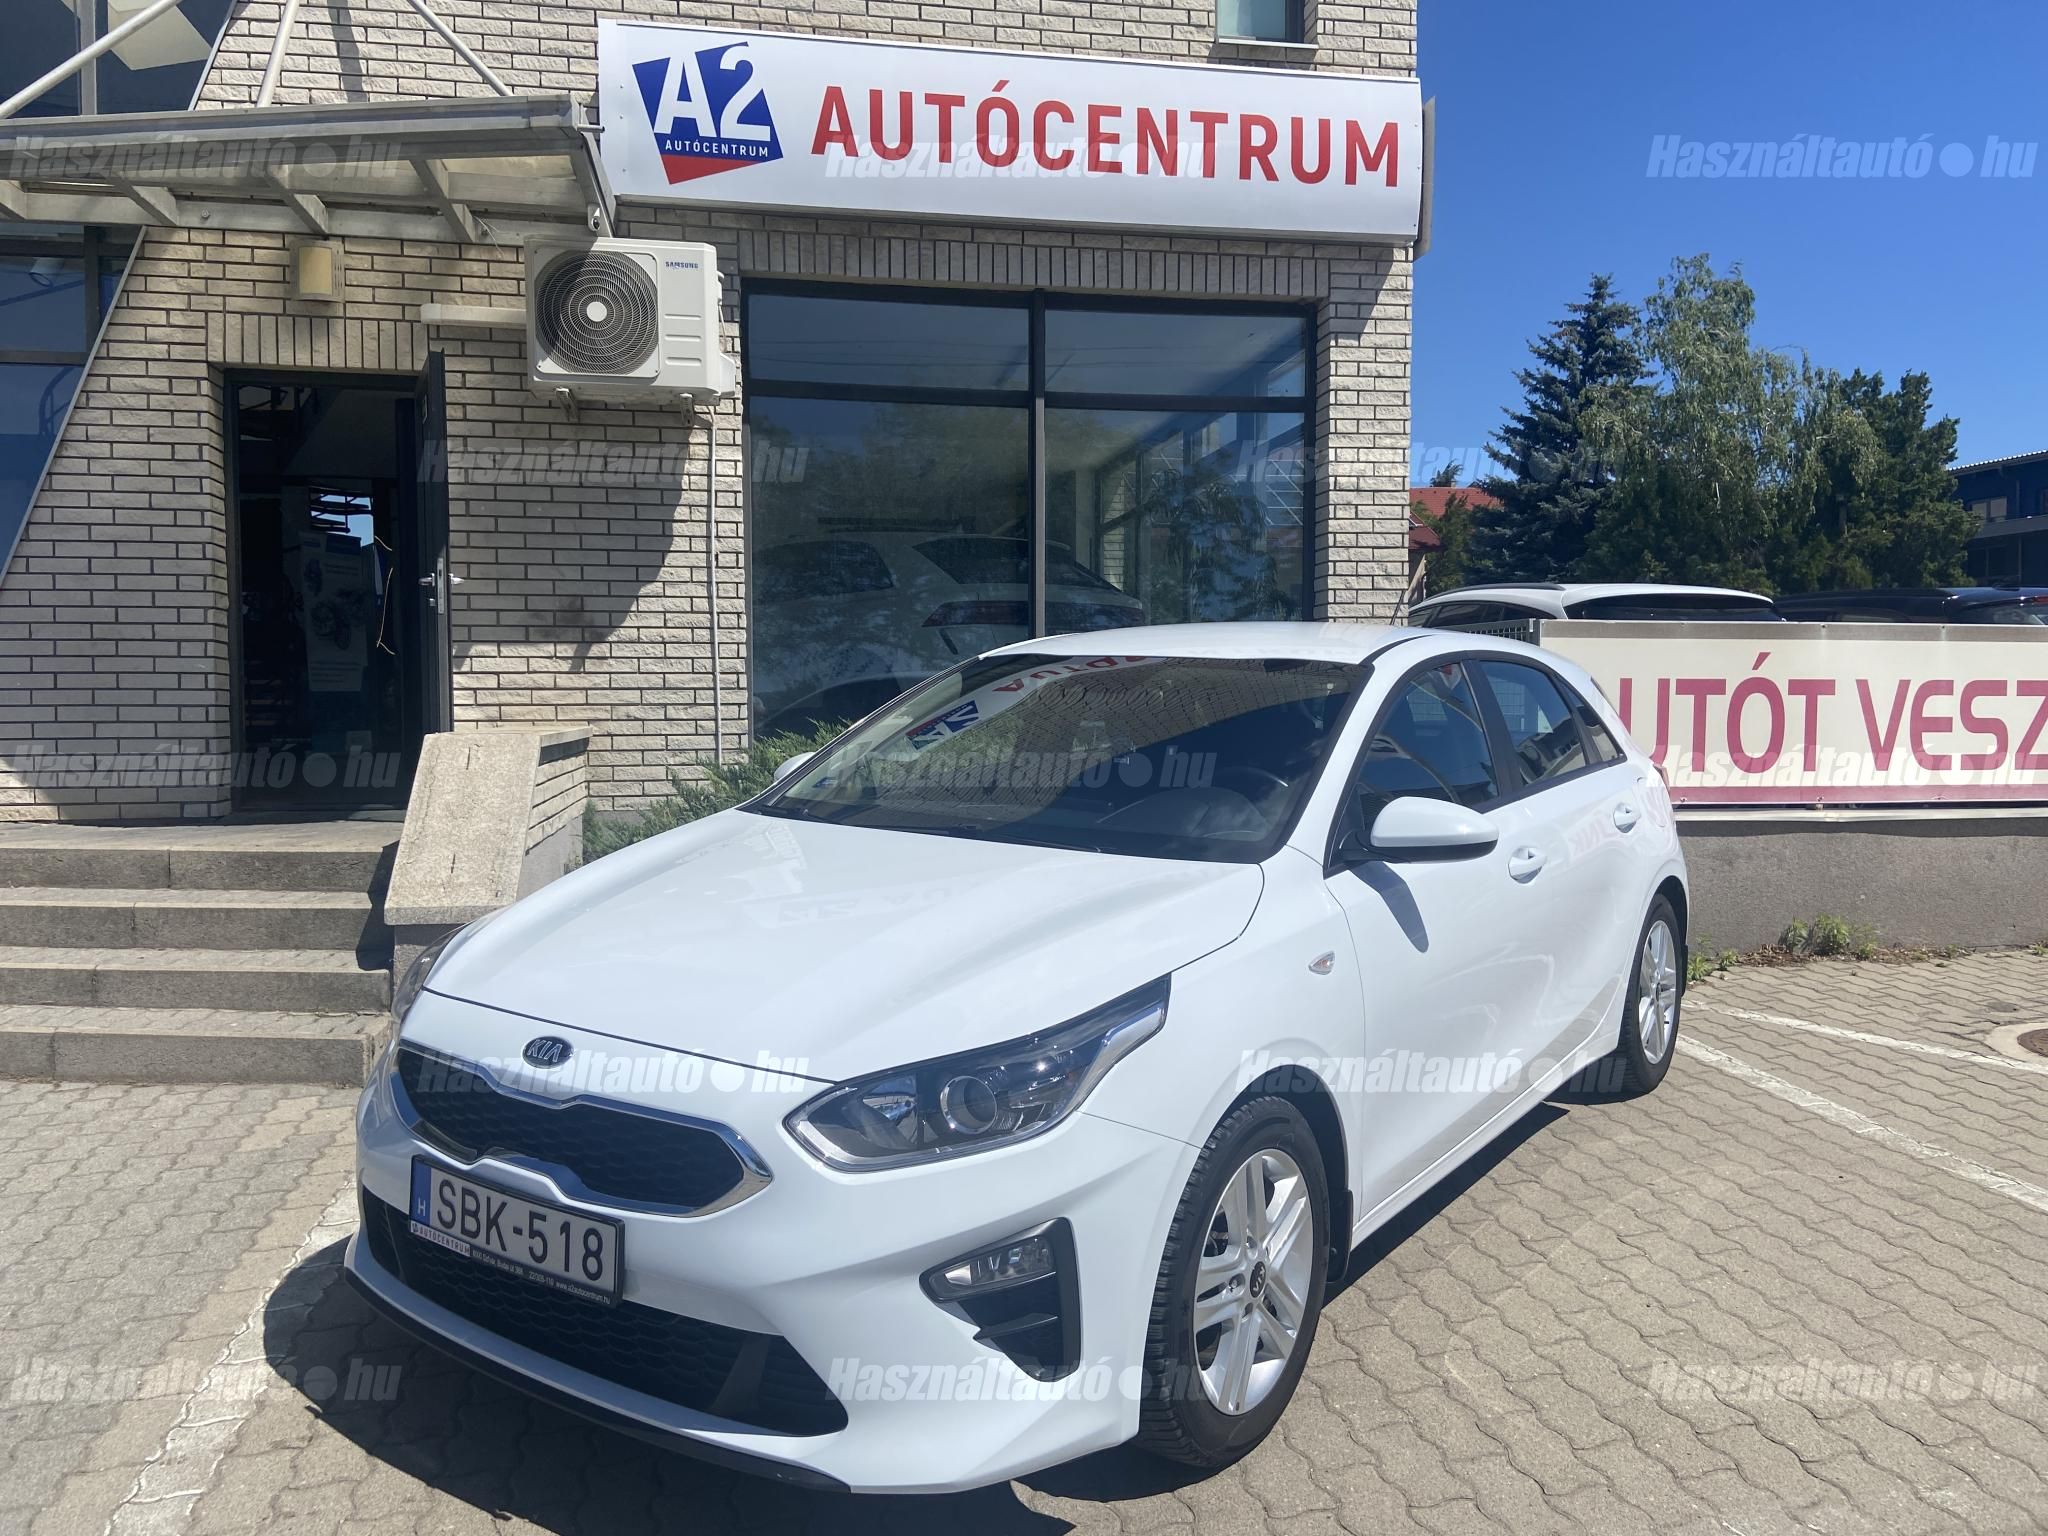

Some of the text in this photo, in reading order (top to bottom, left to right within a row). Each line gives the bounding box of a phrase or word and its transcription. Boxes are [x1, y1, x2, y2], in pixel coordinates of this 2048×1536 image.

[654, 45, 771, 142] A2
[812, 80, 1400, 188] AUTÓCENTRUM
[665, 139, 768, 158] AUTÓCENTRUM
[665, 261, 699, 269] SAMSUNG
[526, 1039, 563, 1063] KIA
[418, 1199, 426, 1217] H
[437, 1179, 603, 1282] SBK-518
